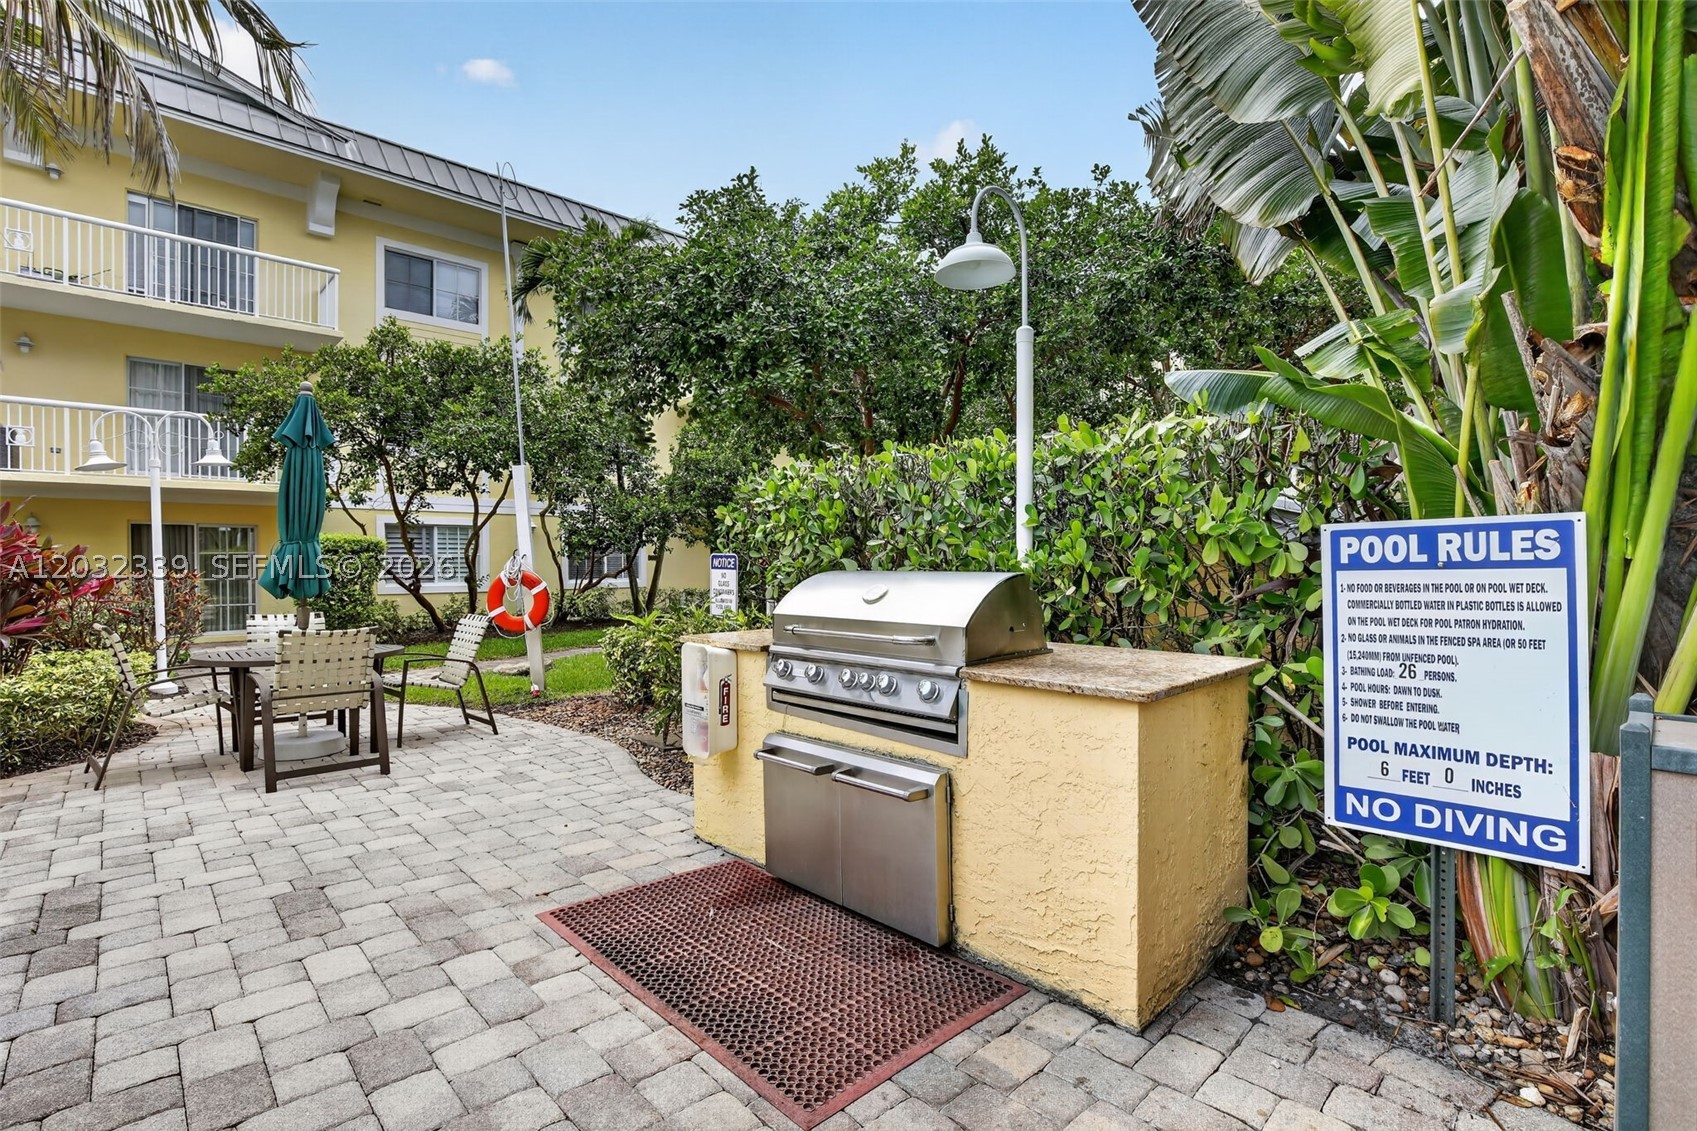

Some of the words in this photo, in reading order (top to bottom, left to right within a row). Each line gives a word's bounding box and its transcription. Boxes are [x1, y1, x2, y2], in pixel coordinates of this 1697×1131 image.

[1340, 534, 1428, 564] POOL
[1437, 528, 1561, 562] RULES
[712, 558, 735, 568] NOTICE
[1347, 584, 1355, 593] NO
[1357, 584, 1373, 593] FOOD
[1374, 584, 1383, 593] OR
[1384, 583, 1421, 593] BEVERAGES
[1422, 583, 1430, 593] IN
[1431, 583, 1443, 593] THE
[1445, 583, 1463, 593] POOL
[1465, 583, 1474, 593] OR
[1476, 583, 1486, 593] ON
[1488, 583, 1507, 593] POOL
[1509, 583, 1524, 593] WET
[1526, 583, 1548, 593] DECK.
[1347, 600, 1394, 609] COMMERCIALLY
[1396, 600, 1422, 610] BOTTLED
[1424, 601, 1445, 610] WATER
[1447, 601, 1454, 610] IN
[1456, 601, 1484, 610] PLASTIC
[1486, 601, 1515, 611] BOTTLES
[1517, 602, 1524, 611] IS
[1526, 602, 1562, 612] ALLOWED
[1348, 617, 1356, 626] ON
[1357, 617, 1368, 626] THE
[1370, 617, 1386, 626] POOL
[1387, 618, 1400, 627] WET
[1402, 618, 1418, 627] DECK
[1420, 618, 1433, 628] FOR
[1435, 619, 1452, 629] POOL
[1454, 619, 1480, 629] PATRON
[1482, 620, 1525, 631] HYDRATION.
[1341, 634, 1346, 643] 2-
[1348, 633, 1356, 642] NO
[1358, 634, 1376, 642] GLASS
[1378, 634, 1387, 643] OR
[1389, 635, 1416, 644] ANIMALS
[1418, 635, 1425, 645] IN
[1426, 636, 1438, 646] THE
[1440, 636, 1466, 646] FENCED
[1467, 637, 1480, 647] SPA
[1482, 638, 1501, 648] AREA
[1503, 638, 1515, 650] (OR
[1518, 639, 1527, 649] 50
[1529, 640, 1546, 650] FEET
[1347, 650, 1382, 662] (15,240MM)
[1383, 652, 1400, 662] FROM
[1402, 653, 1435, 664] UNFENCED
[1437, 655, 1459, 667] POOL).
[1350, 667, 1375, 676] BATHING
[1377, 668, 1394, 678] LOAD:
[1399, 663, 1417, 679] 26
[1424, 671, 1457, 682] PERSONS.
[1351, 683, 1366, 692] POOL
[1368, 684, 1390, 694] HOURS:
[1394, 686, 1412, 696] DAWN
[1414, 687, 1421, 696] TO
[1423, 688, 1442, 698] DUSK.
[1351, 698, 1376, 708] SHOWER
[1380, 700, 1403, 711] BEFORE
[1406, 702, 1439, 714] ENTERING.
[1351, 714, 1359, 722] DO
[1361, 715, 1372, 724] NOT
[1374, 715, 1404, 727] SWALLOW
[1406, 718, 1417, 729] THE
[1419, 720, 1436, 731] POOL
[1438, 722, 1460, 734] WATER
[1347, 737, 1389, 754] POOL
[1394, 742, 1480, 765] MAXIMUM
[1486, 752, 1553, 775] DEPTH:
[1380, 761, 1389, 777] 6
[1402, 769, 1430, 785] FEET
[1444, 768, 1454, 784] 0
[1471, 779, 1521, 799] INCHES
[1346, 792, 1400, 822] NO
[1415, 803, 1567, 852] DIVING
